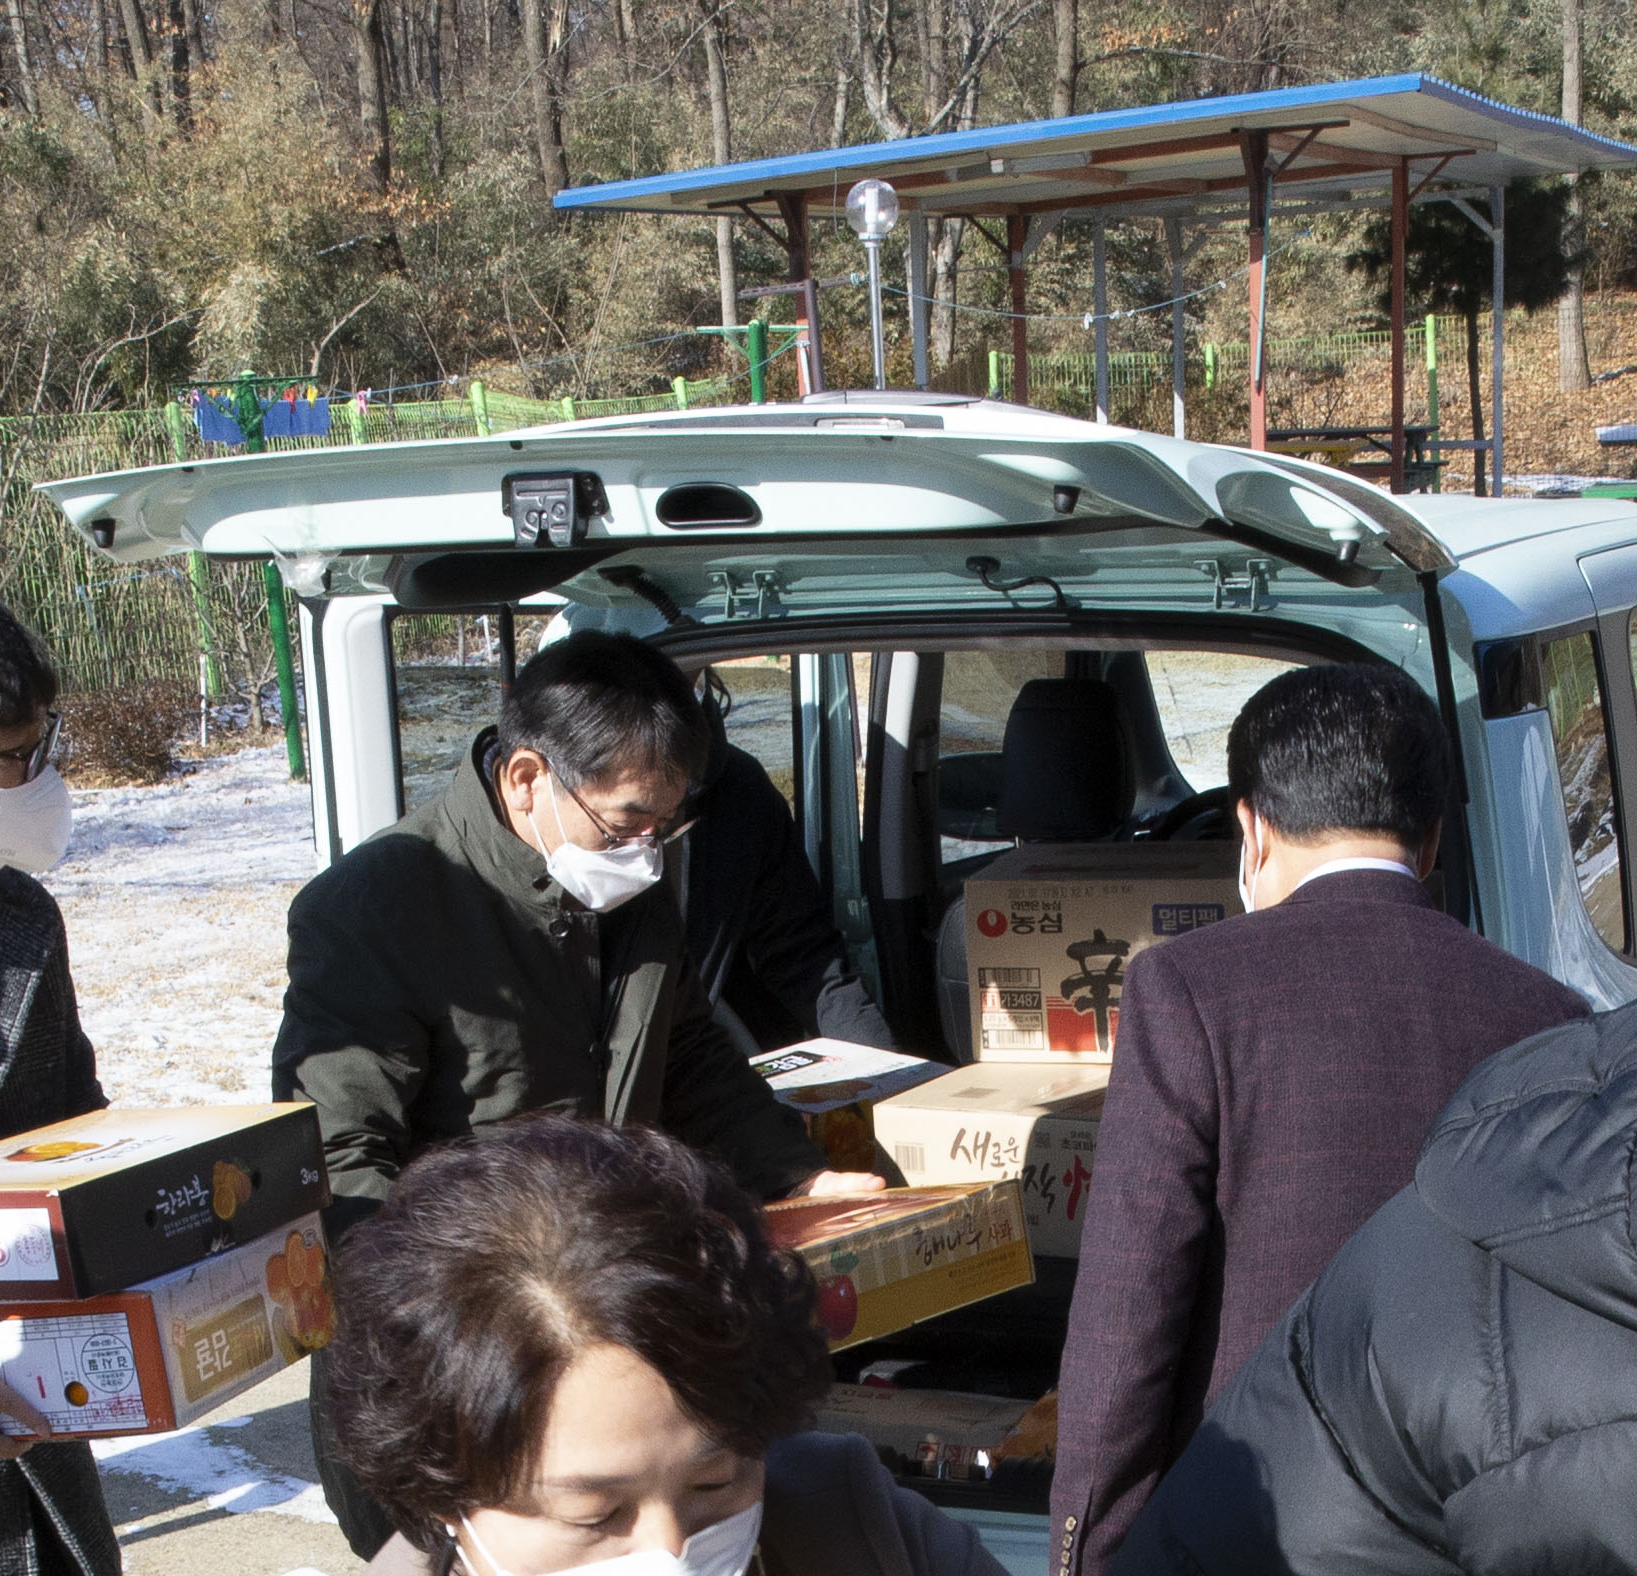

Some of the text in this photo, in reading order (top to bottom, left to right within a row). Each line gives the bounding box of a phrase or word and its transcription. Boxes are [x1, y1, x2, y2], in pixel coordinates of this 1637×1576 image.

[1010, 913, 1062, 934] 농심
[1001, 993, 1040, 1009] 가3487
[950, 1128, 1021, 1170] 새로운
[299, 1167, 319, 1185] 3kg
[156, 1175, 209, 1216] 한라봉
